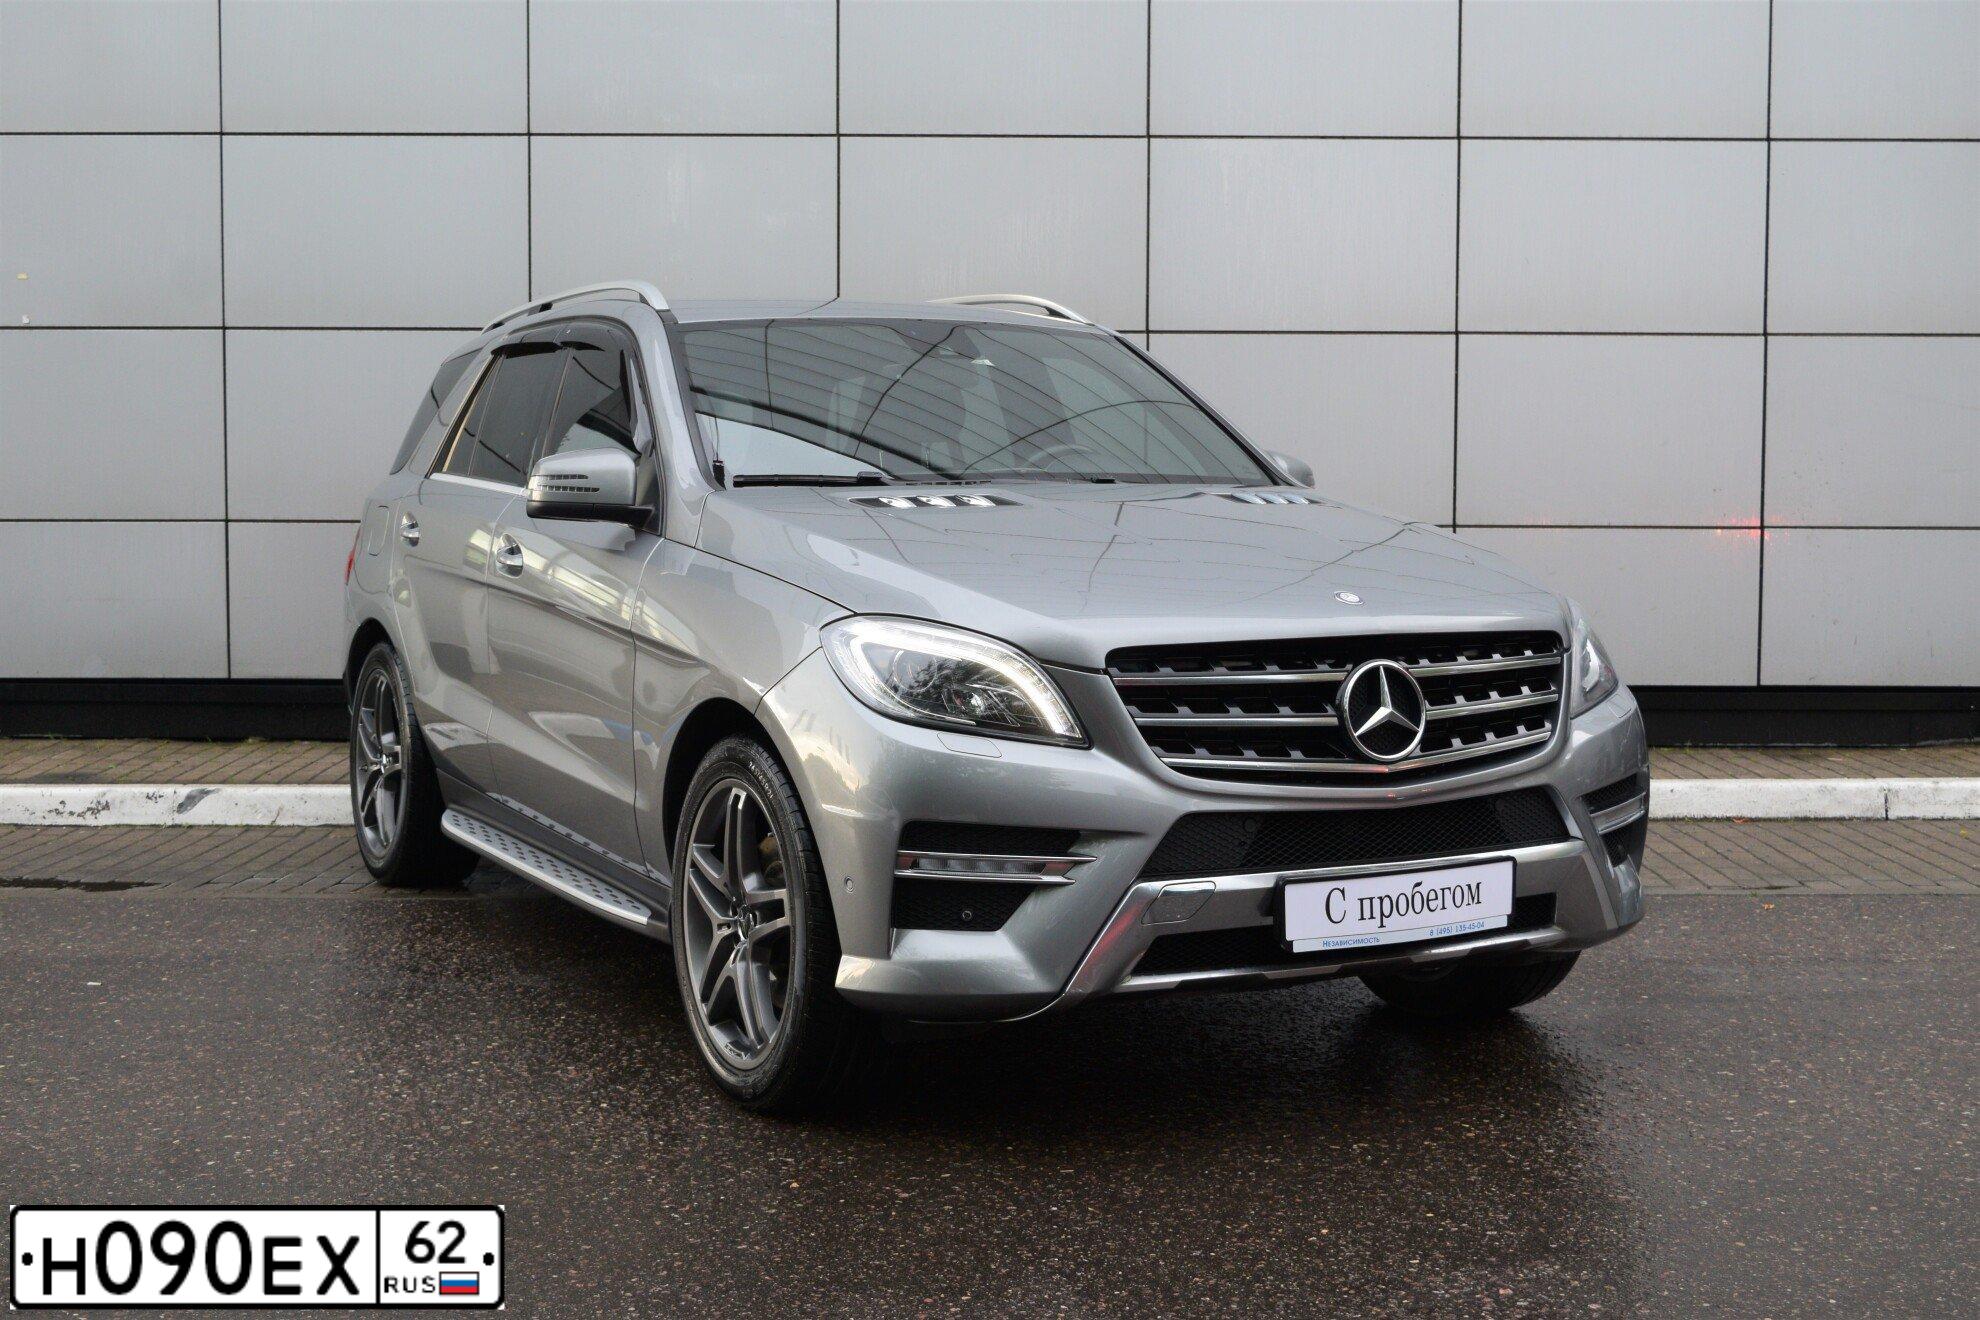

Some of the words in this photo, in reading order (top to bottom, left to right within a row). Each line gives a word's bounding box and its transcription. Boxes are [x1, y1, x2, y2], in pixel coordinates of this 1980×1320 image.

[1325, 886, 1347, 924] С
[1357, 881, 1483, 928] пробегом
[1436, 926, 1453, 936] (495)
[1455, 921, 1485, 934] 135-45-04
[1322, 936, 1381, 948] НЕЗАВИСИМОСТЬ
